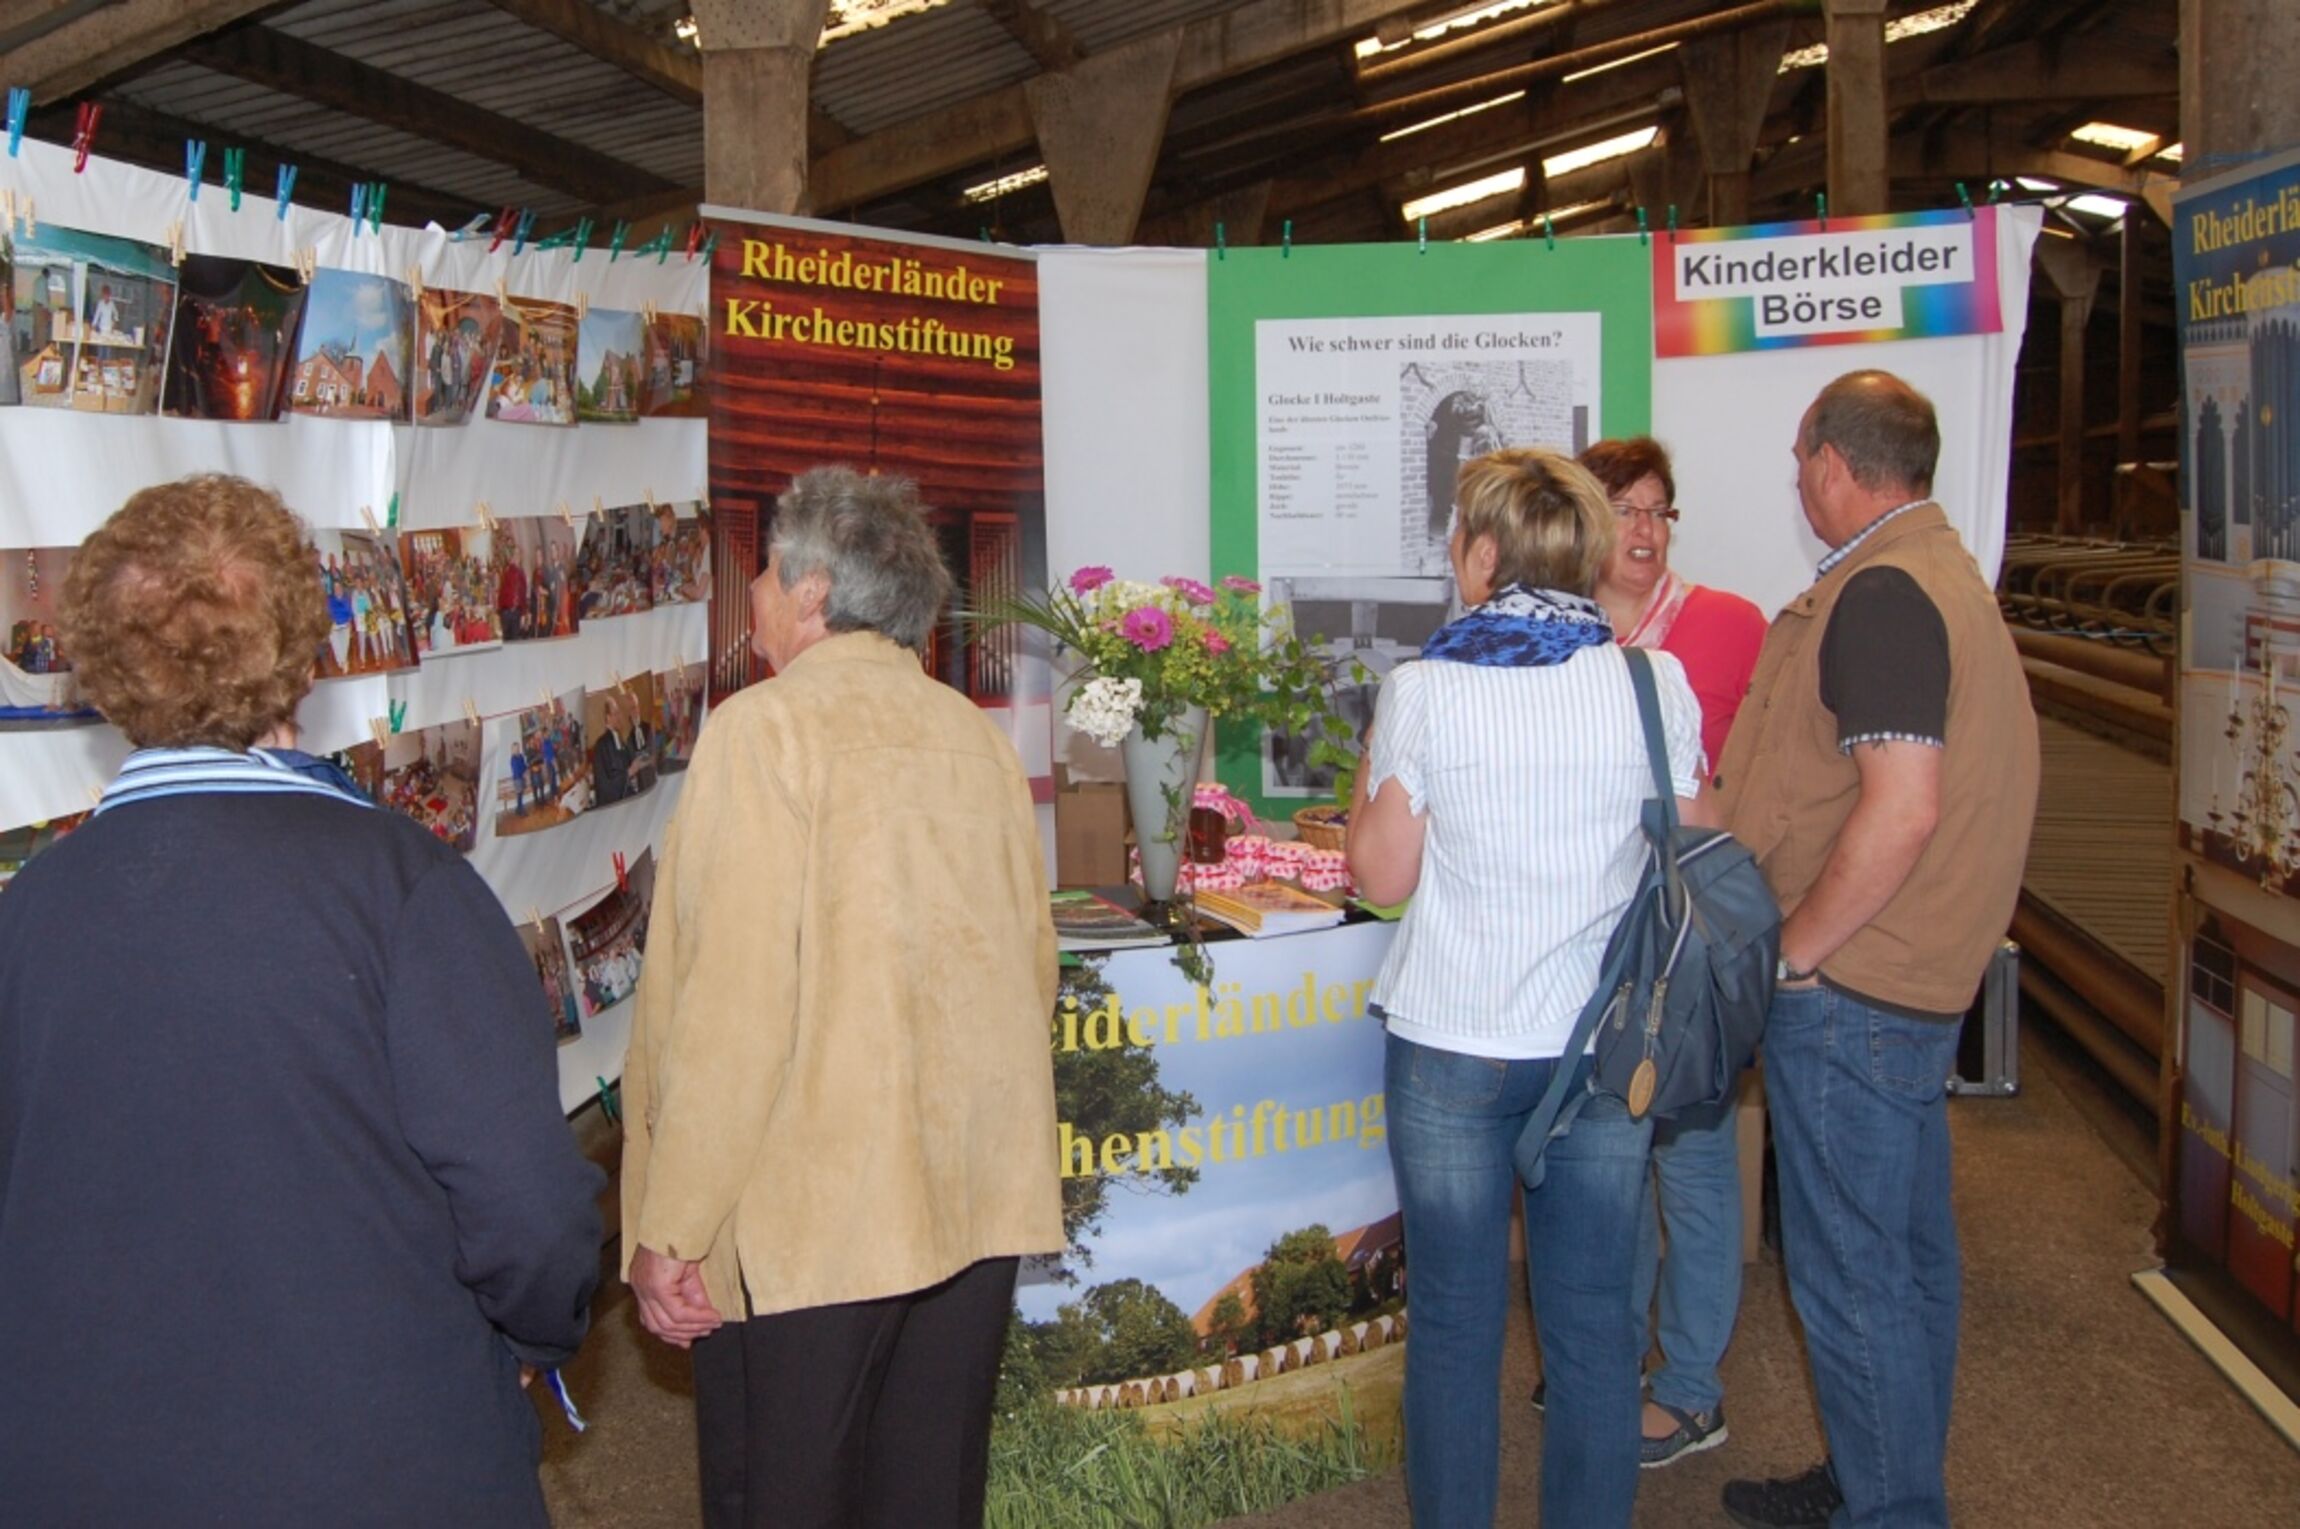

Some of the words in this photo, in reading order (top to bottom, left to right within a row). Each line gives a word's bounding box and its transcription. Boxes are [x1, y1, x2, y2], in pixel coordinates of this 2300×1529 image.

[739, 239, 1003, 305] Rheiderländer
[1682, 241, 1959, 287] Kinderkleider
[725, 298, 1015, 371] Kirchenstiftung
[1762, 292, 1883, 326] Börse
[1288, 336, 1325, 352] Wie
[1329, 335, 1394, 352] schwer
[1398, 333, 1436, 351] sind
[1441, 332, 1469, 350] die
[1474, 331, 1562, 350] Glocken?
[1268, 393, 1311, 405] Glocke
[1050, 971, 1375, 1051] iderländer
[1057, 1091, 1386, 1178] henstiftung
